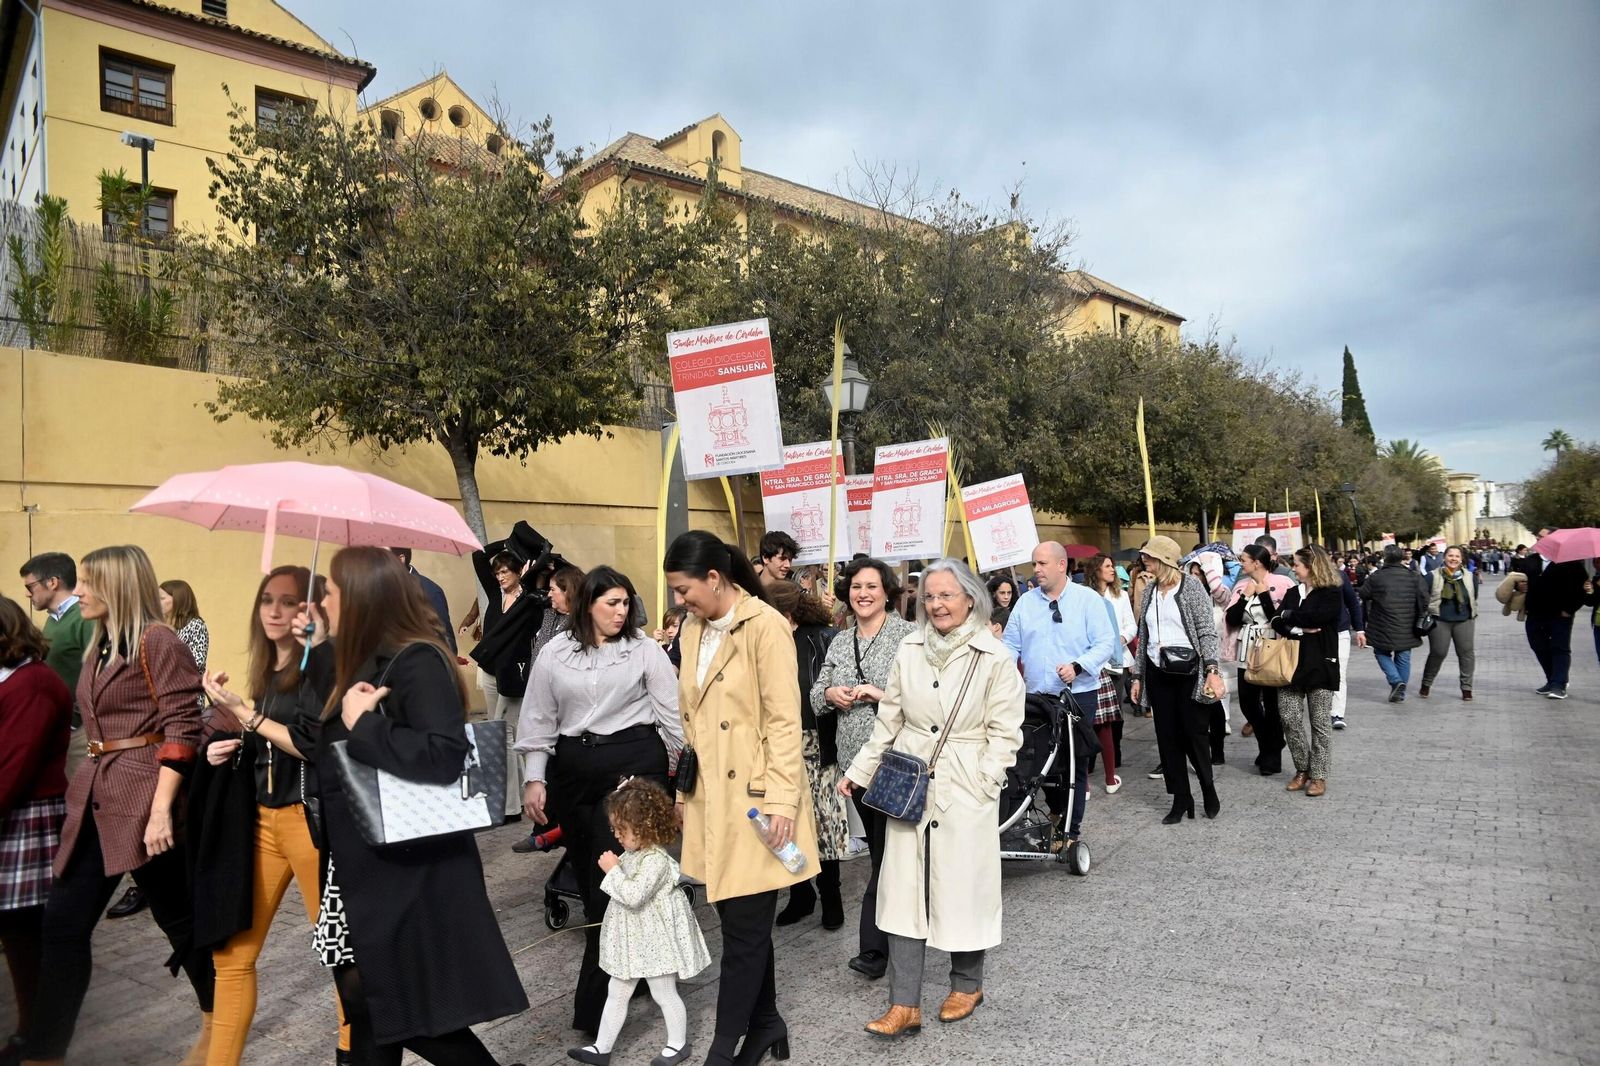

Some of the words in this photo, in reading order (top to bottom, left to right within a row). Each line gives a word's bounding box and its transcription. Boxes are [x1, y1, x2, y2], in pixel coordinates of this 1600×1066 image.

[725, 331, 733, 340] de
[674, 356, 713, 370] COLEGIO
[714, 349, 766, 365] DIOCESANO
[677, 368, 716, 381] TRINIDAD
[718, 361, 768, 376] SANSUEÑA
[814, 472, 841, 480] GRACA
[919, 468, 943, 477] GRACIA
[786, 481, 814, 489] FRANCISCO
[853, 498, 872, 506] MILAG
[972, 507, 981, 515] LA
[982, 498, 1020, 512] MILAGROSA
